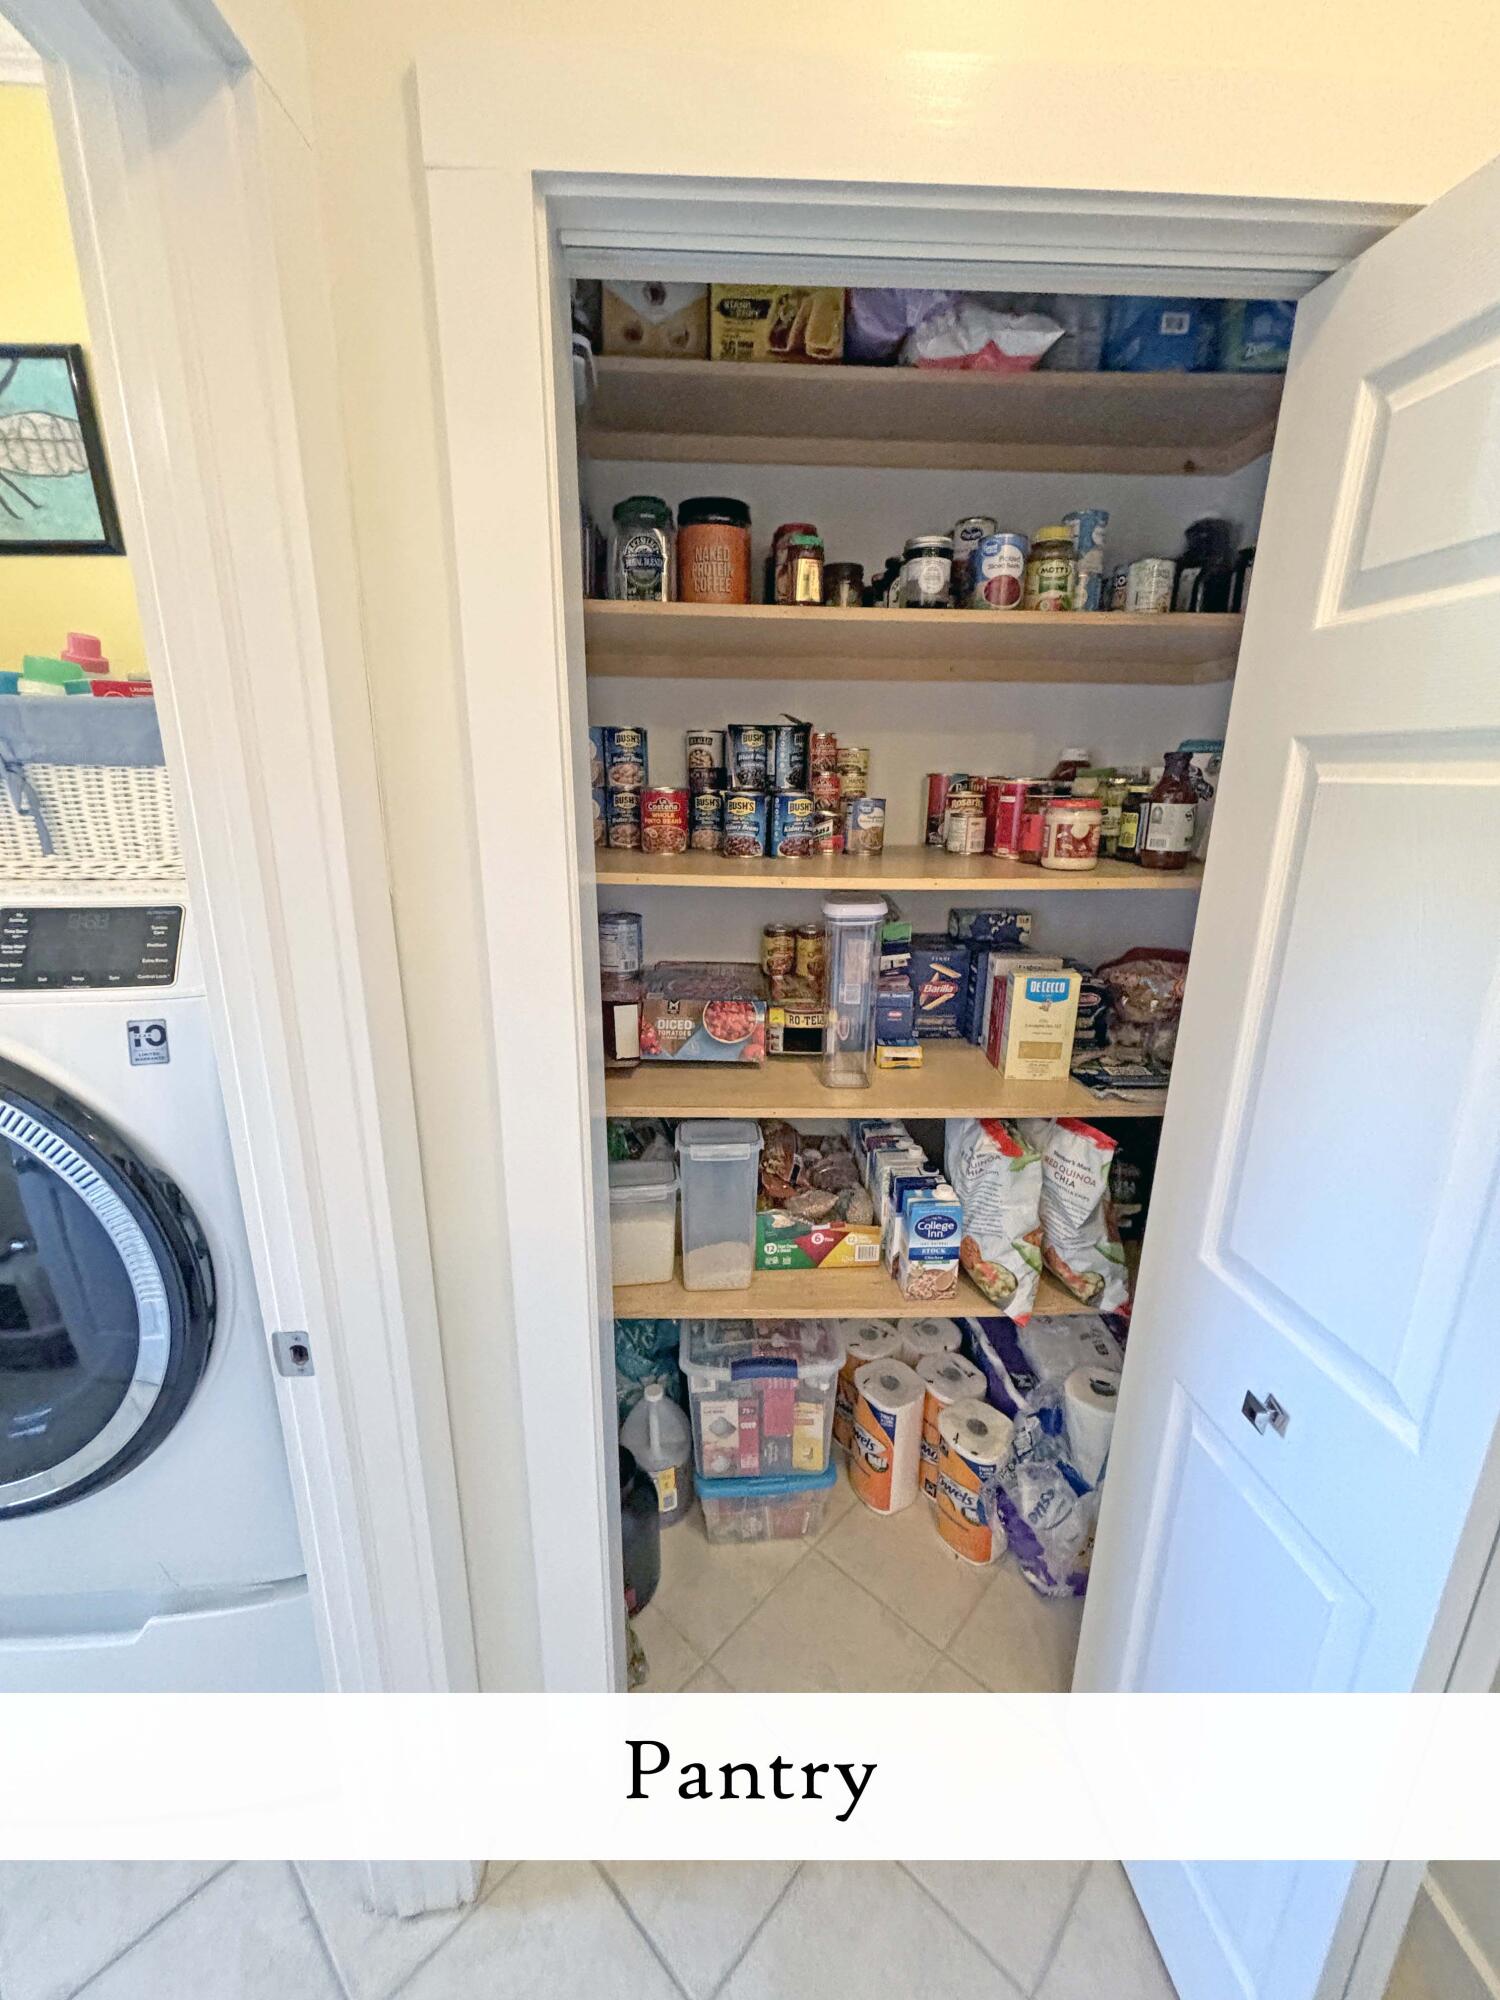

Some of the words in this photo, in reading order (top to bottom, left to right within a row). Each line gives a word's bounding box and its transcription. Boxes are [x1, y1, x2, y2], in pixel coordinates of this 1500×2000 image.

[695, 546, 730, 562] NAKED
[694, 577, 732, 592] COFFEE
[616, 734, 641, 745] BUSH'S
[696, 798, 720, 807] BUSH'S
[728, 801, 755, 812] BUSH'S
[662, 817, 682, 825] BEANS
[923, 984, 954, 993] Barilla
[1030, 981, 1041, 992] DE
[1042, 981, 1065, 993] CECCO
[657, 1019, 693, 1030] DICED
[128, 1024, 167, 1047] 10
[969, 1154, 1001, 1169] UINOA
[967, 1167, 985, 1176] HIA
[1044, 1155, 1059, 1169] RED
[1059, 1164, 1096, 1188] QUINOA
[1053, 1171, 1076, 1189] CHIA
[917, 1220, 955, 1232] College
[927, 1229, 944, 1238] Inn
[766, 1245, 775, 1253] 12
